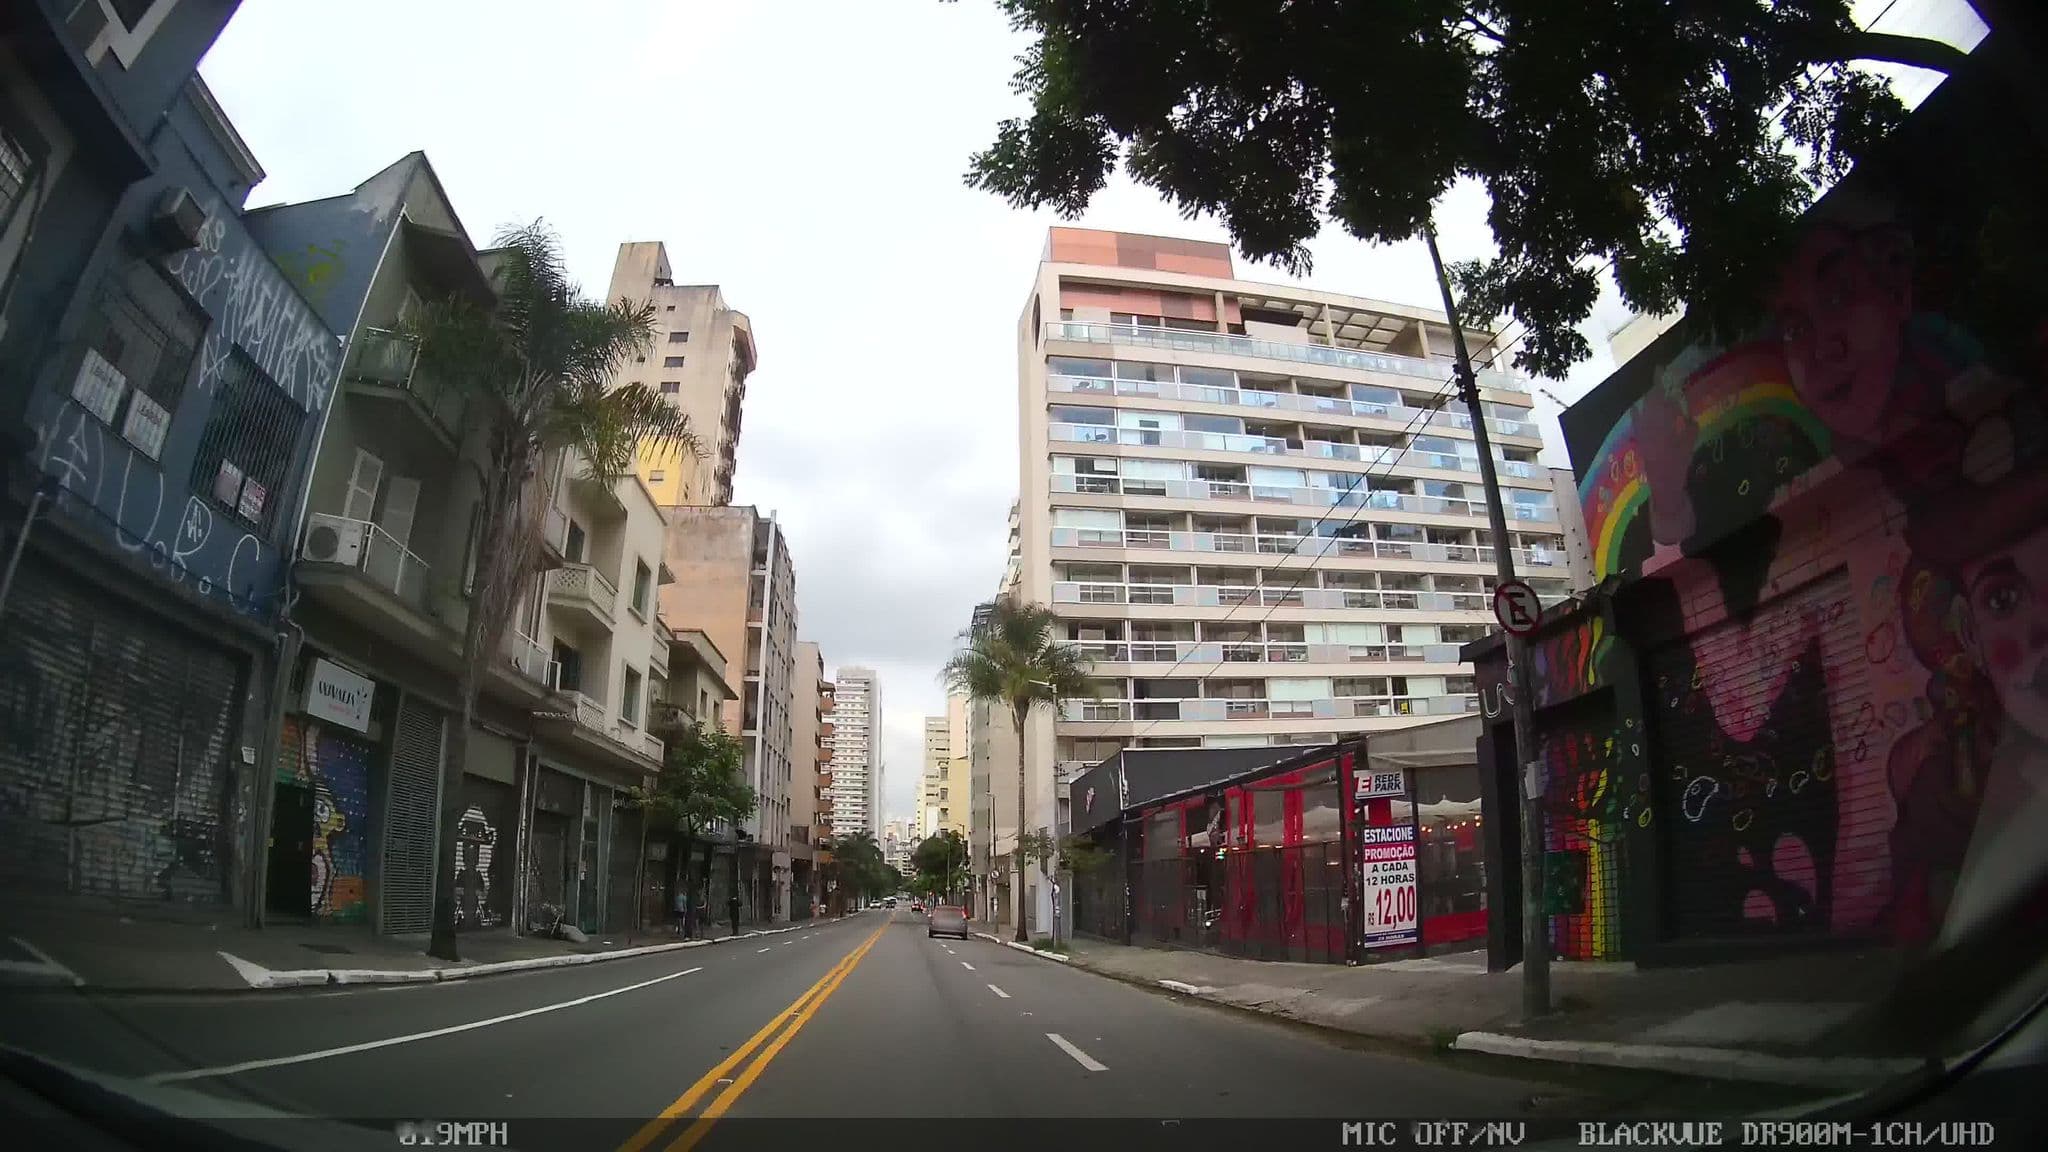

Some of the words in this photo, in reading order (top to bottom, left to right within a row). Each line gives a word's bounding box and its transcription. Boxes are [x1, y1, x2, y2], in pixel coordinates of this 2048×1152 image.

[1374, 773, 1401, 783] REDE
[1374, 782, 1402, 792] PARK
[1363, 826, 1414, 844] ESTACIONE
[1364, 844, 1415, 861] PROMOÇÃO
[1371, 863, 1379, 873] A
[1382, 861, 1409, 872] CADA
[1365, 876, 1378, 886] 12
[1380, 873, 1415, 885] HORAS
[1375, 885, 1416, 930] 12,00
